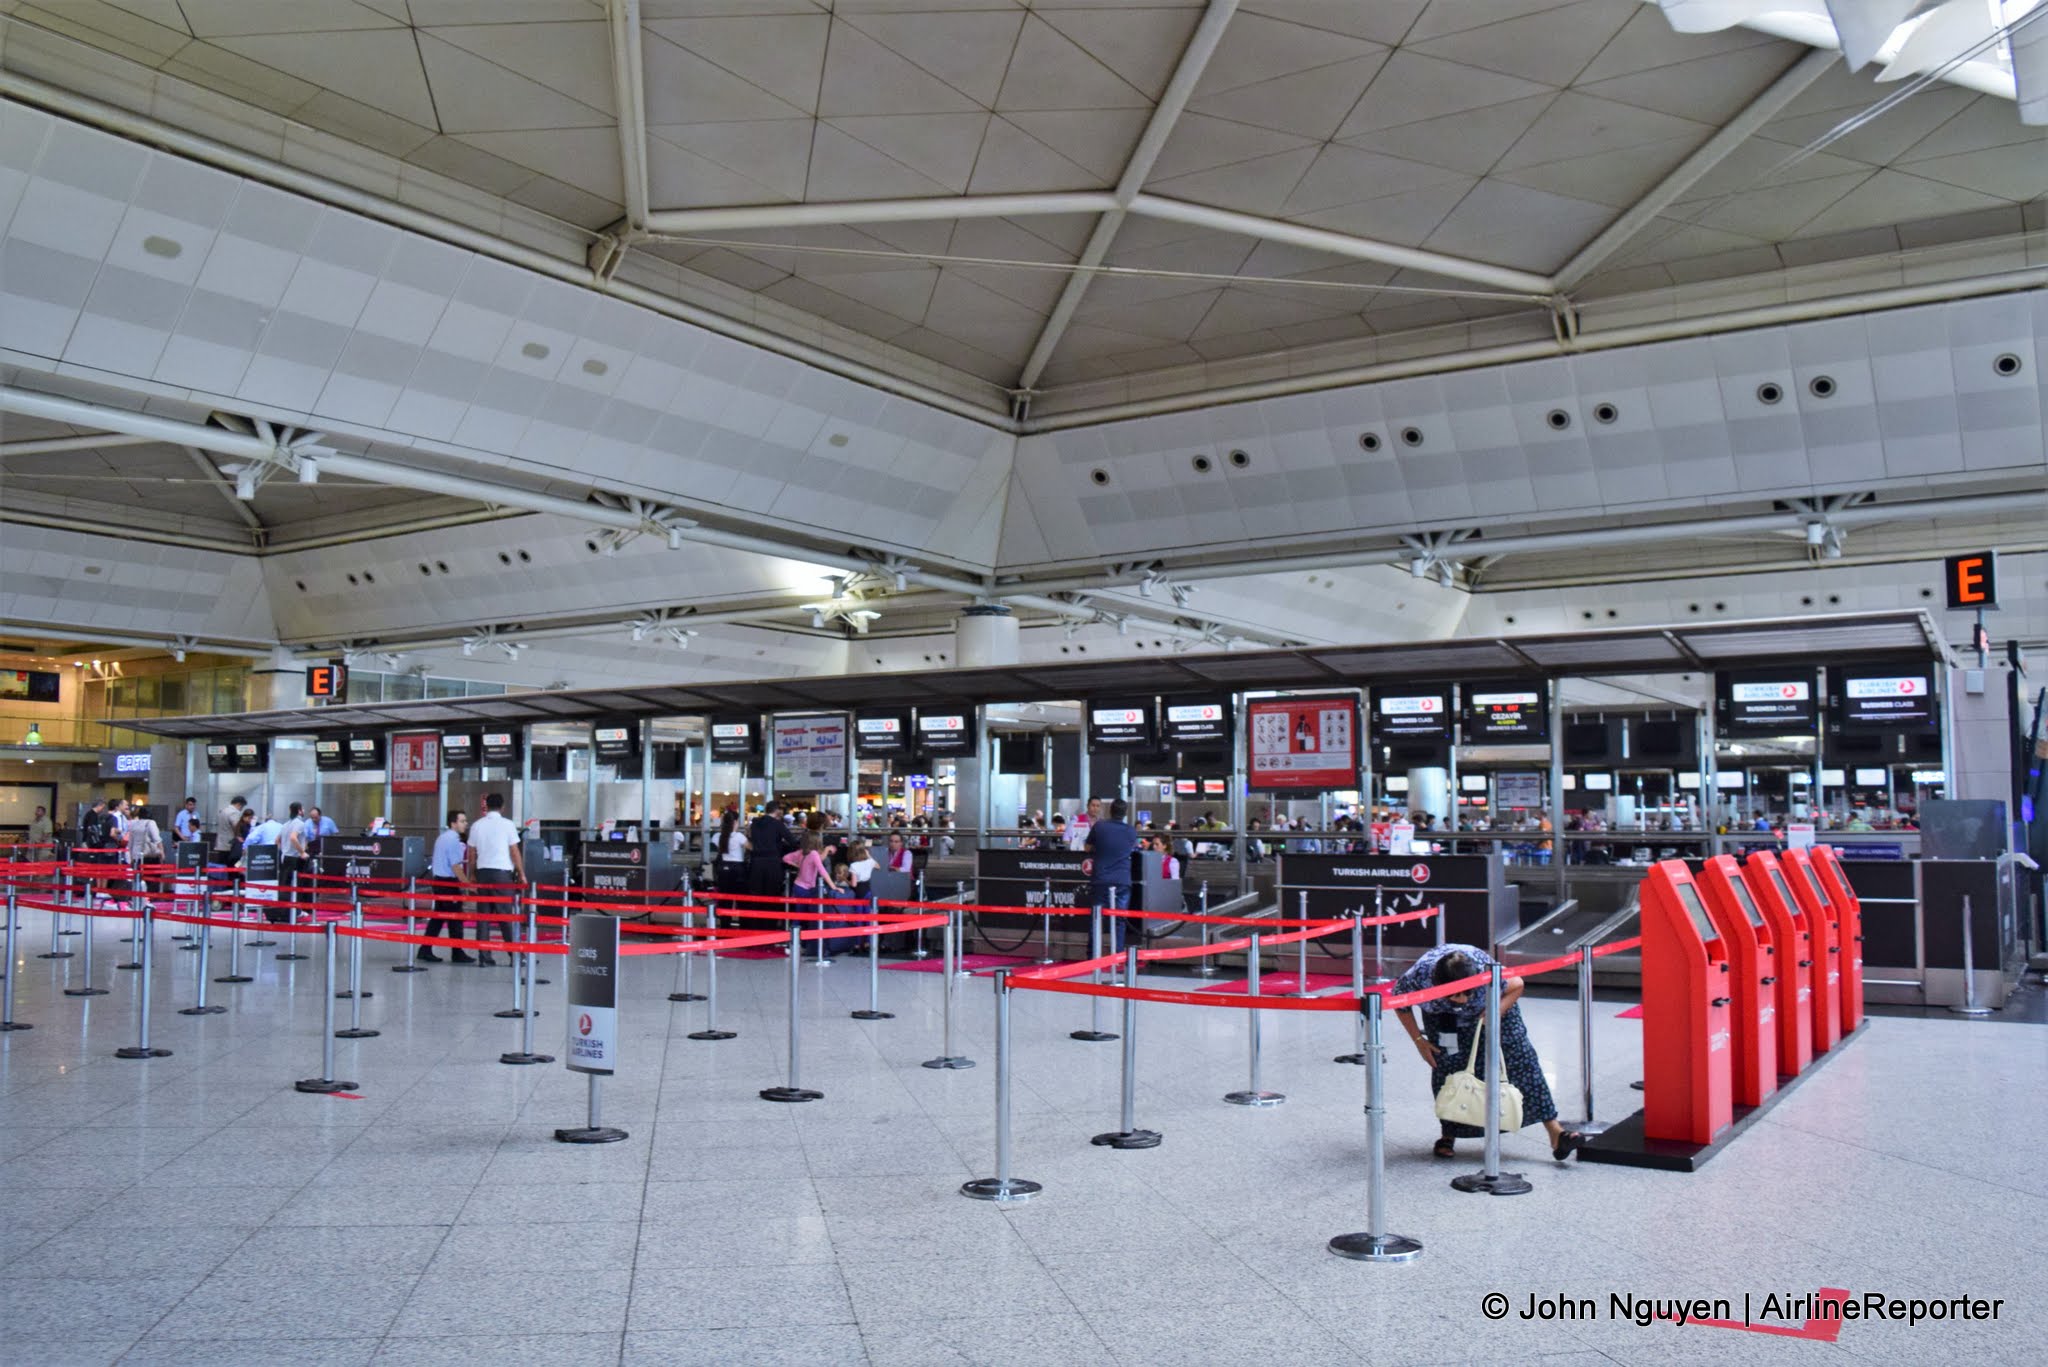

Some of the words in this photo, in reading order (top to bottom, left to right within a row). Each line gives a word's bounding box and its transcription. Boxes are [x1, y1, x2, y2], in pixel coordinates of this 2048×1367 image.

[1958, 558, 1985, 602] E
[312, 669, 329, 694] E
[1019, 862, 1050, 870] TURKISH
[1050, 862, 1082, 871] AIRLINES
[1332, 867, 1371, 877] TURKISH
[1371, 868, 1410, 878] AIRLINES
